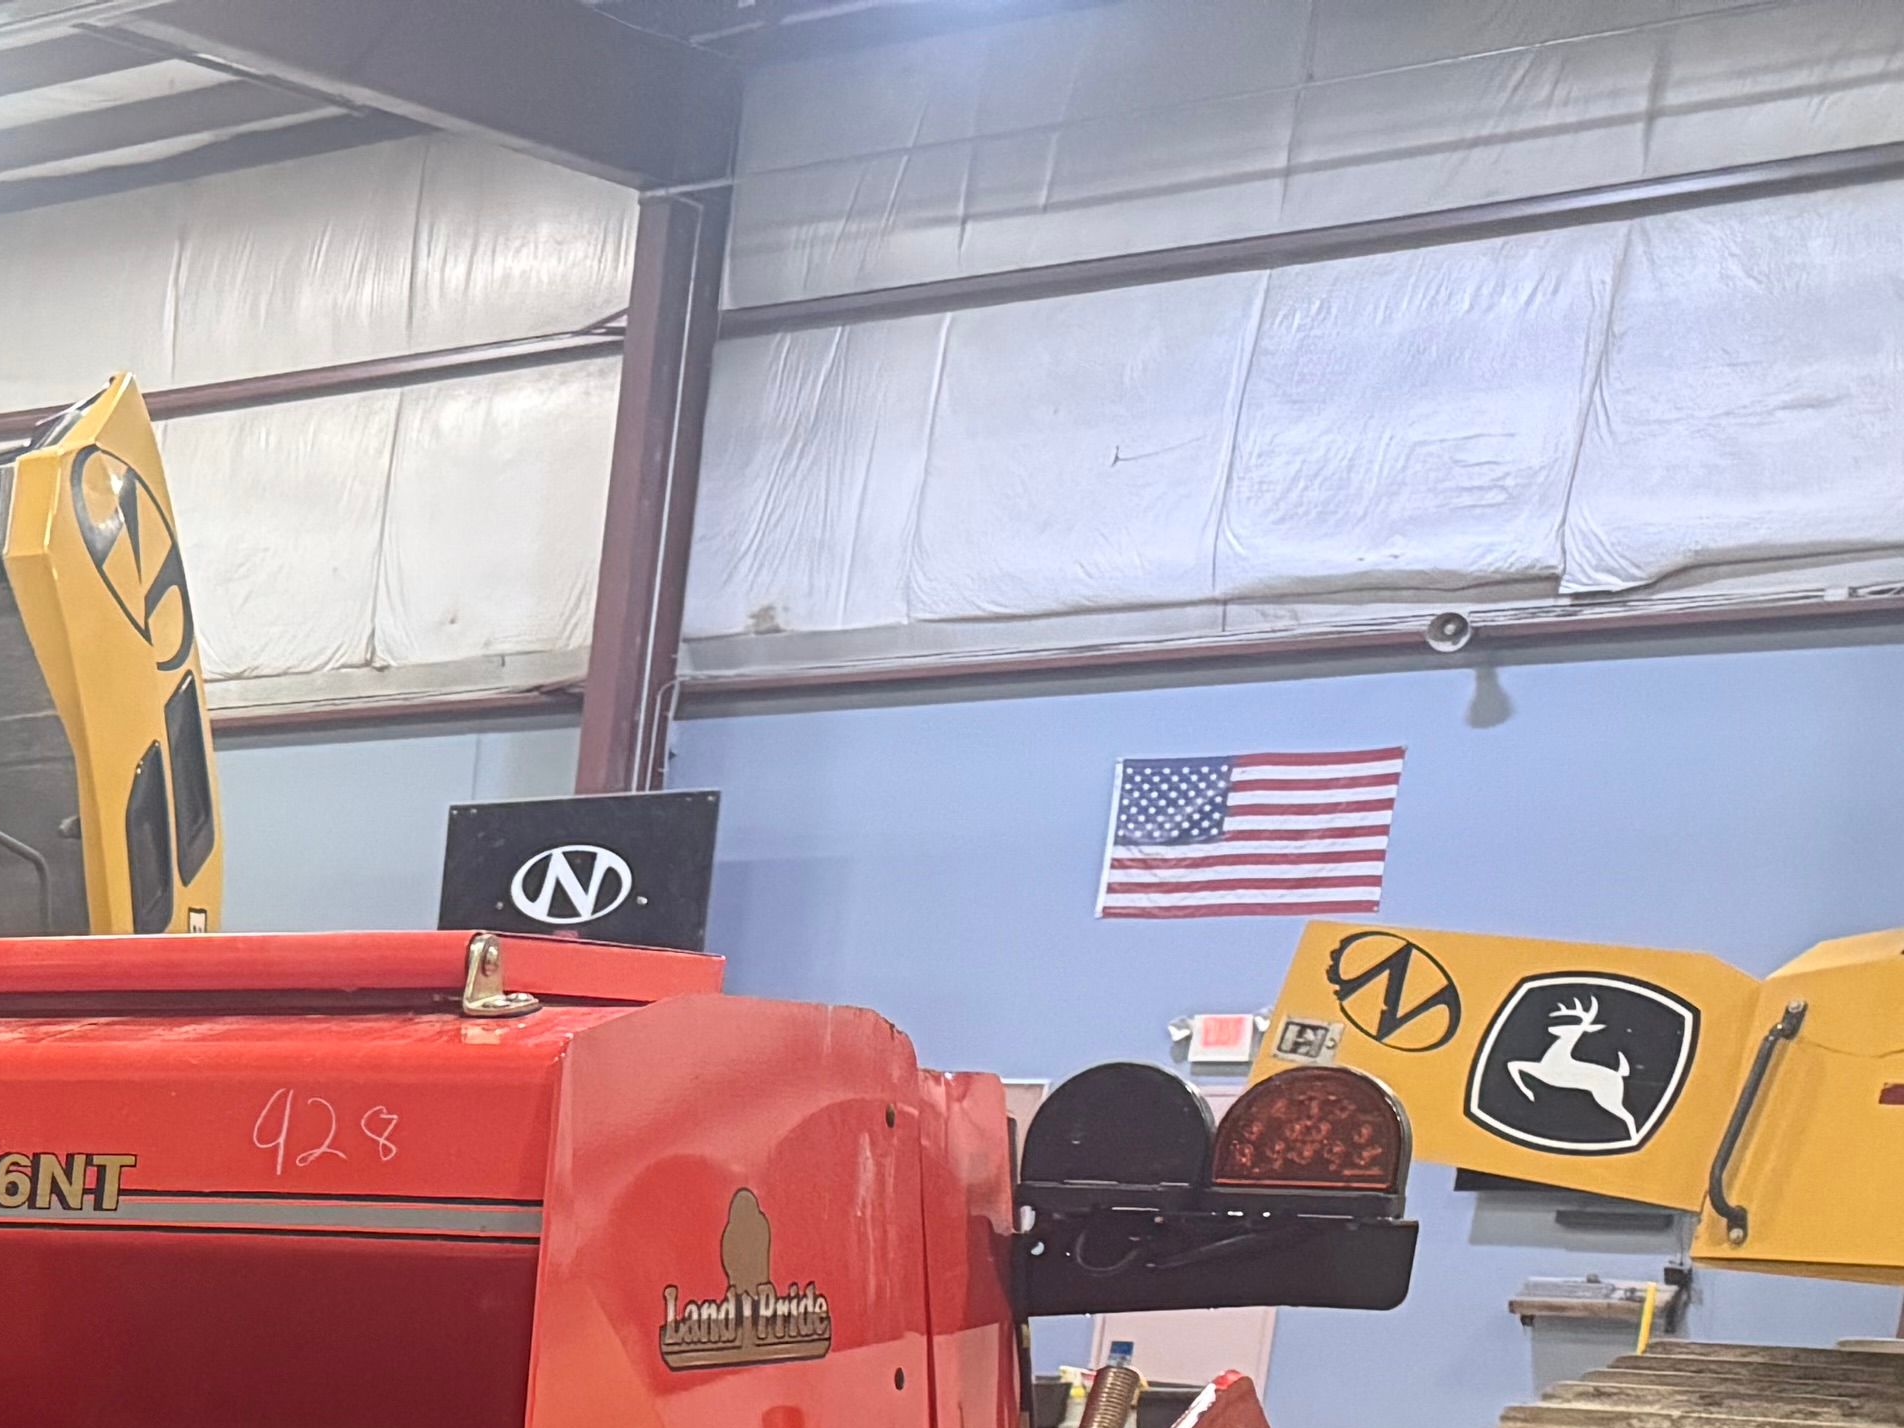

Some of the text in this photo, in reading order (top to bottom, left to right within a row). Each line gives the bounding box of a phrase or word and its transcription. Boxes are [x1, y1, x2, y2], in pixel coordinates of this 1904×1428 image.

[252, 1087, 400, 1176] 928
[662, 1280, 832, 1347] Land Pride
